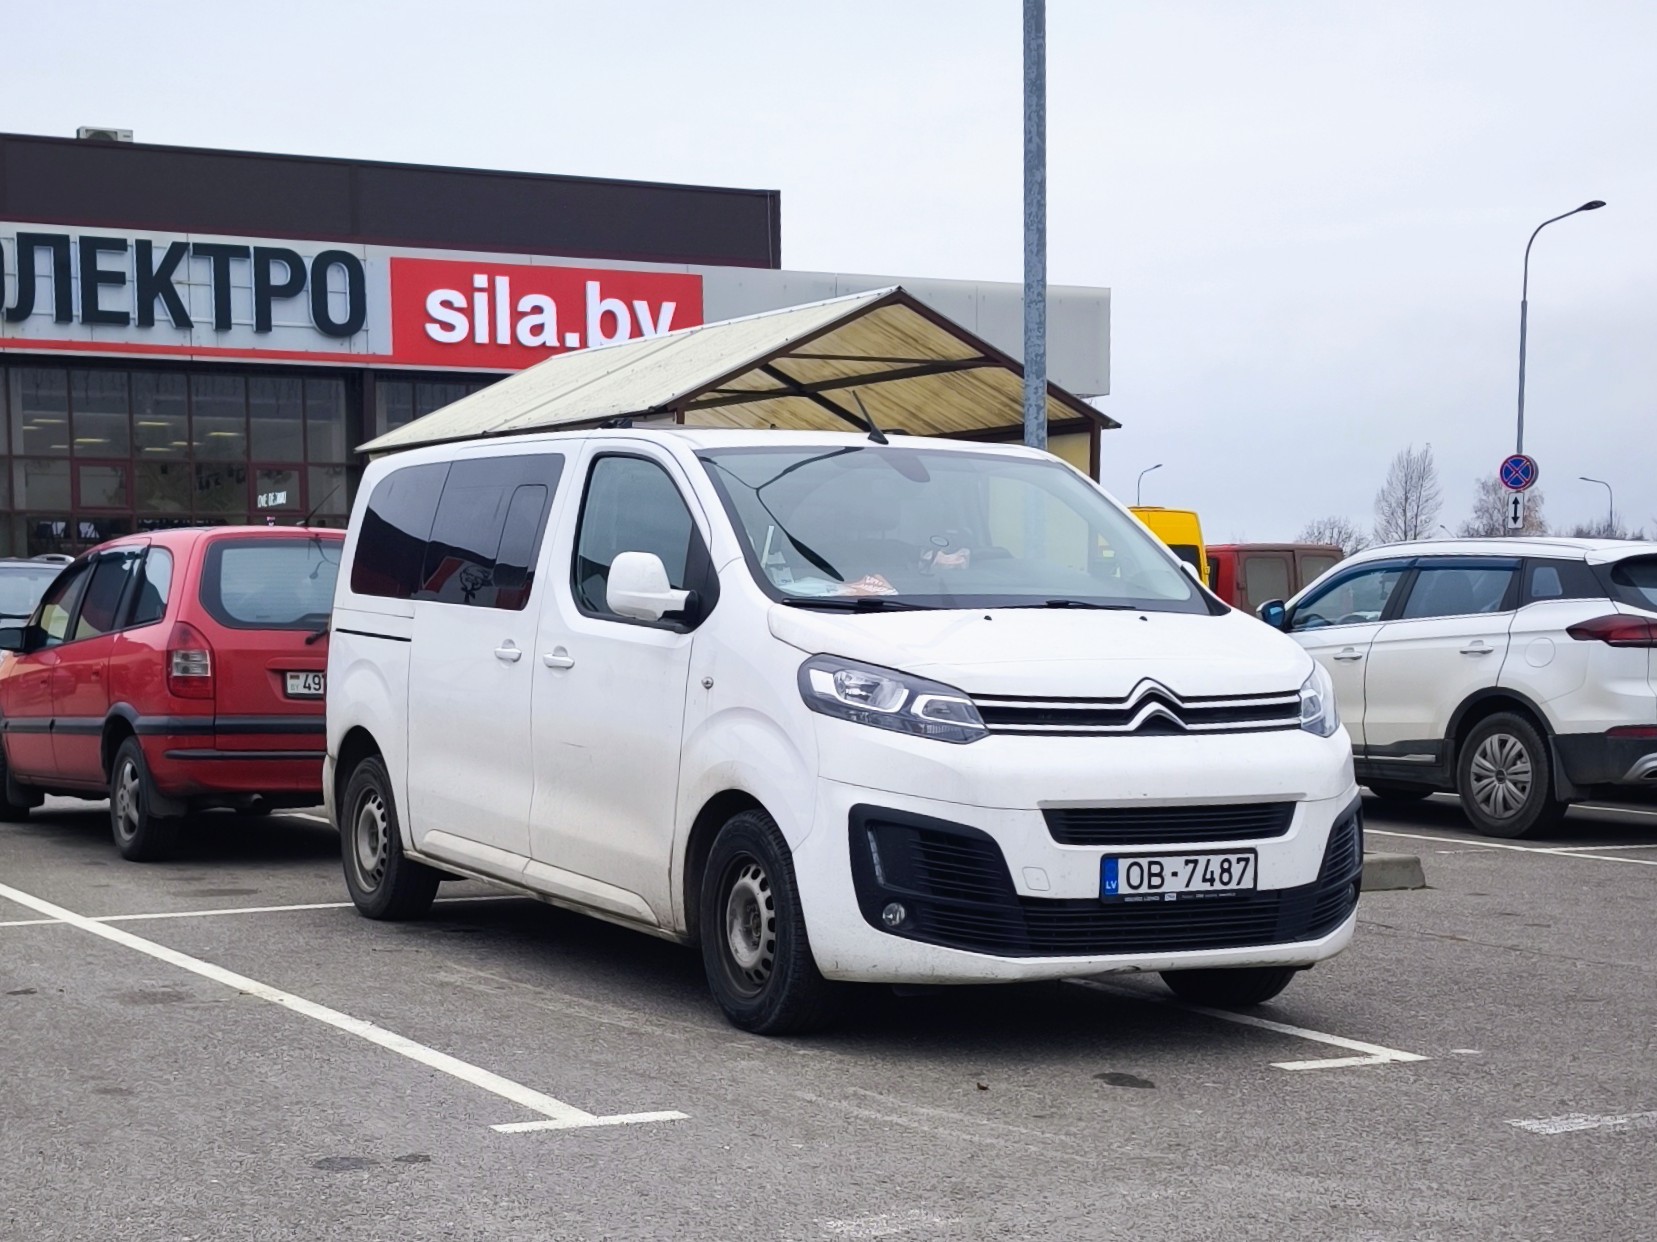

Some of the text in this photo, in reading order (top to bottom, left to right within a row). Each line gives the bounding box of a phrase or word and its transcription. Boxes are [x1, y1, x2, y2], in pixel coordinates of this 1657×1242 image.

[0, 232, 367, 337] ЛЕКТРО
[303, 673, 325, 691] 49
[1105, 880, 1117, 889] LV
[1125, 857, 1250, 890] OB-7487
